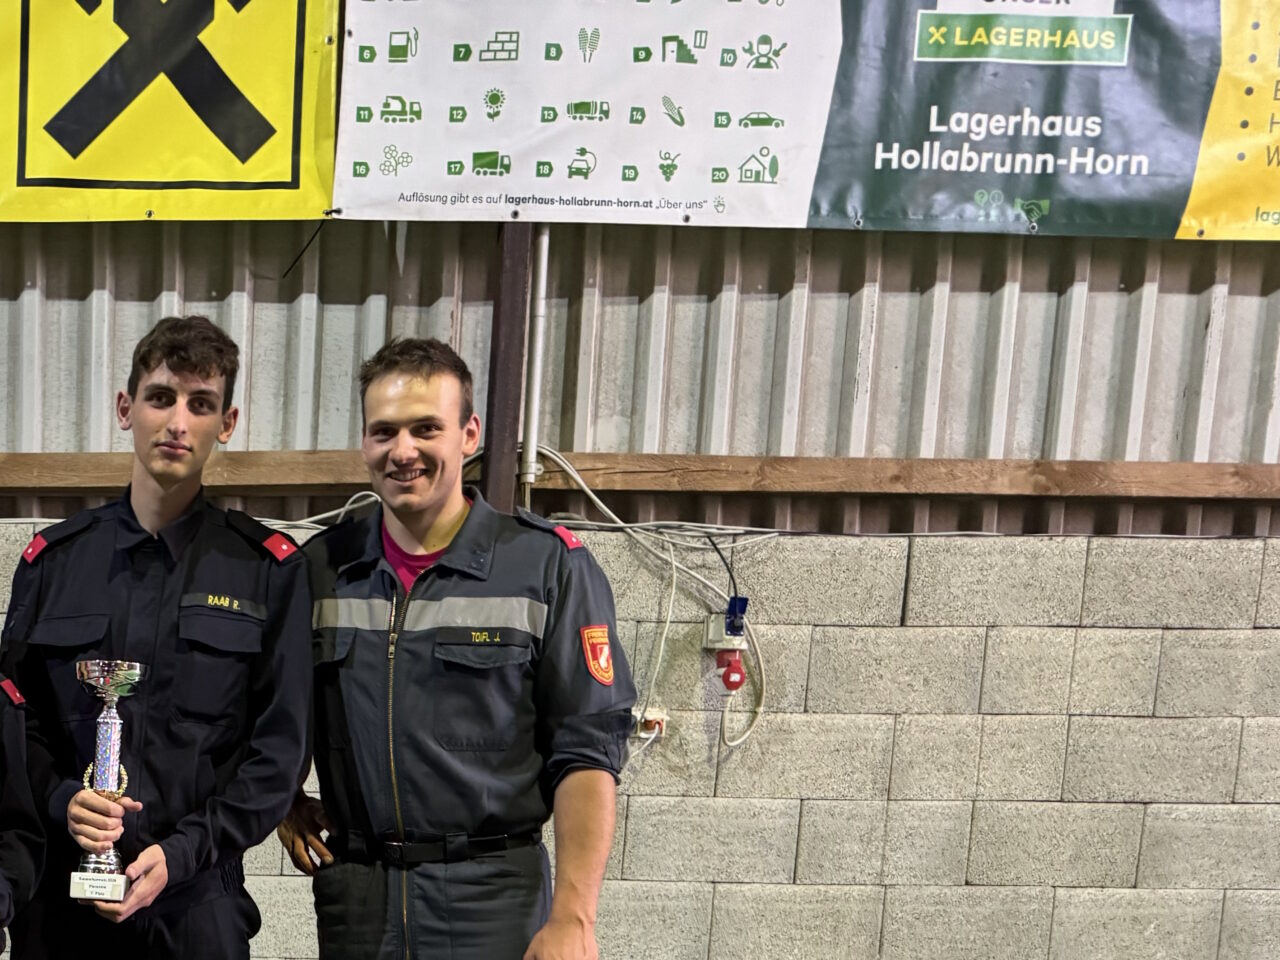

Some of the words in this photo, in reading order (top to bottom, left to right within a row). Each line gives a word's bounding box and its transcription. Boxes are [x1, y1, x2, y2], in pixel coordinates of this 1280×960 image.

[954, 27, 1116, 49] LAGERHAUS
[929, 105, 1102, 141] Lagerhaus
[875, 142, 1149, 176] Hollabrunn-Horn
[398, 192, 448, 205] Auflösung
[450, 193, 469, 205] gibt
[472, 195, 483, 204] es
[486, 194, 502, 204] auf
[505, 194, 653, 208] lagerhaus-hollabrunn-horn.at
[207, 595, 230, 607] RAAB
